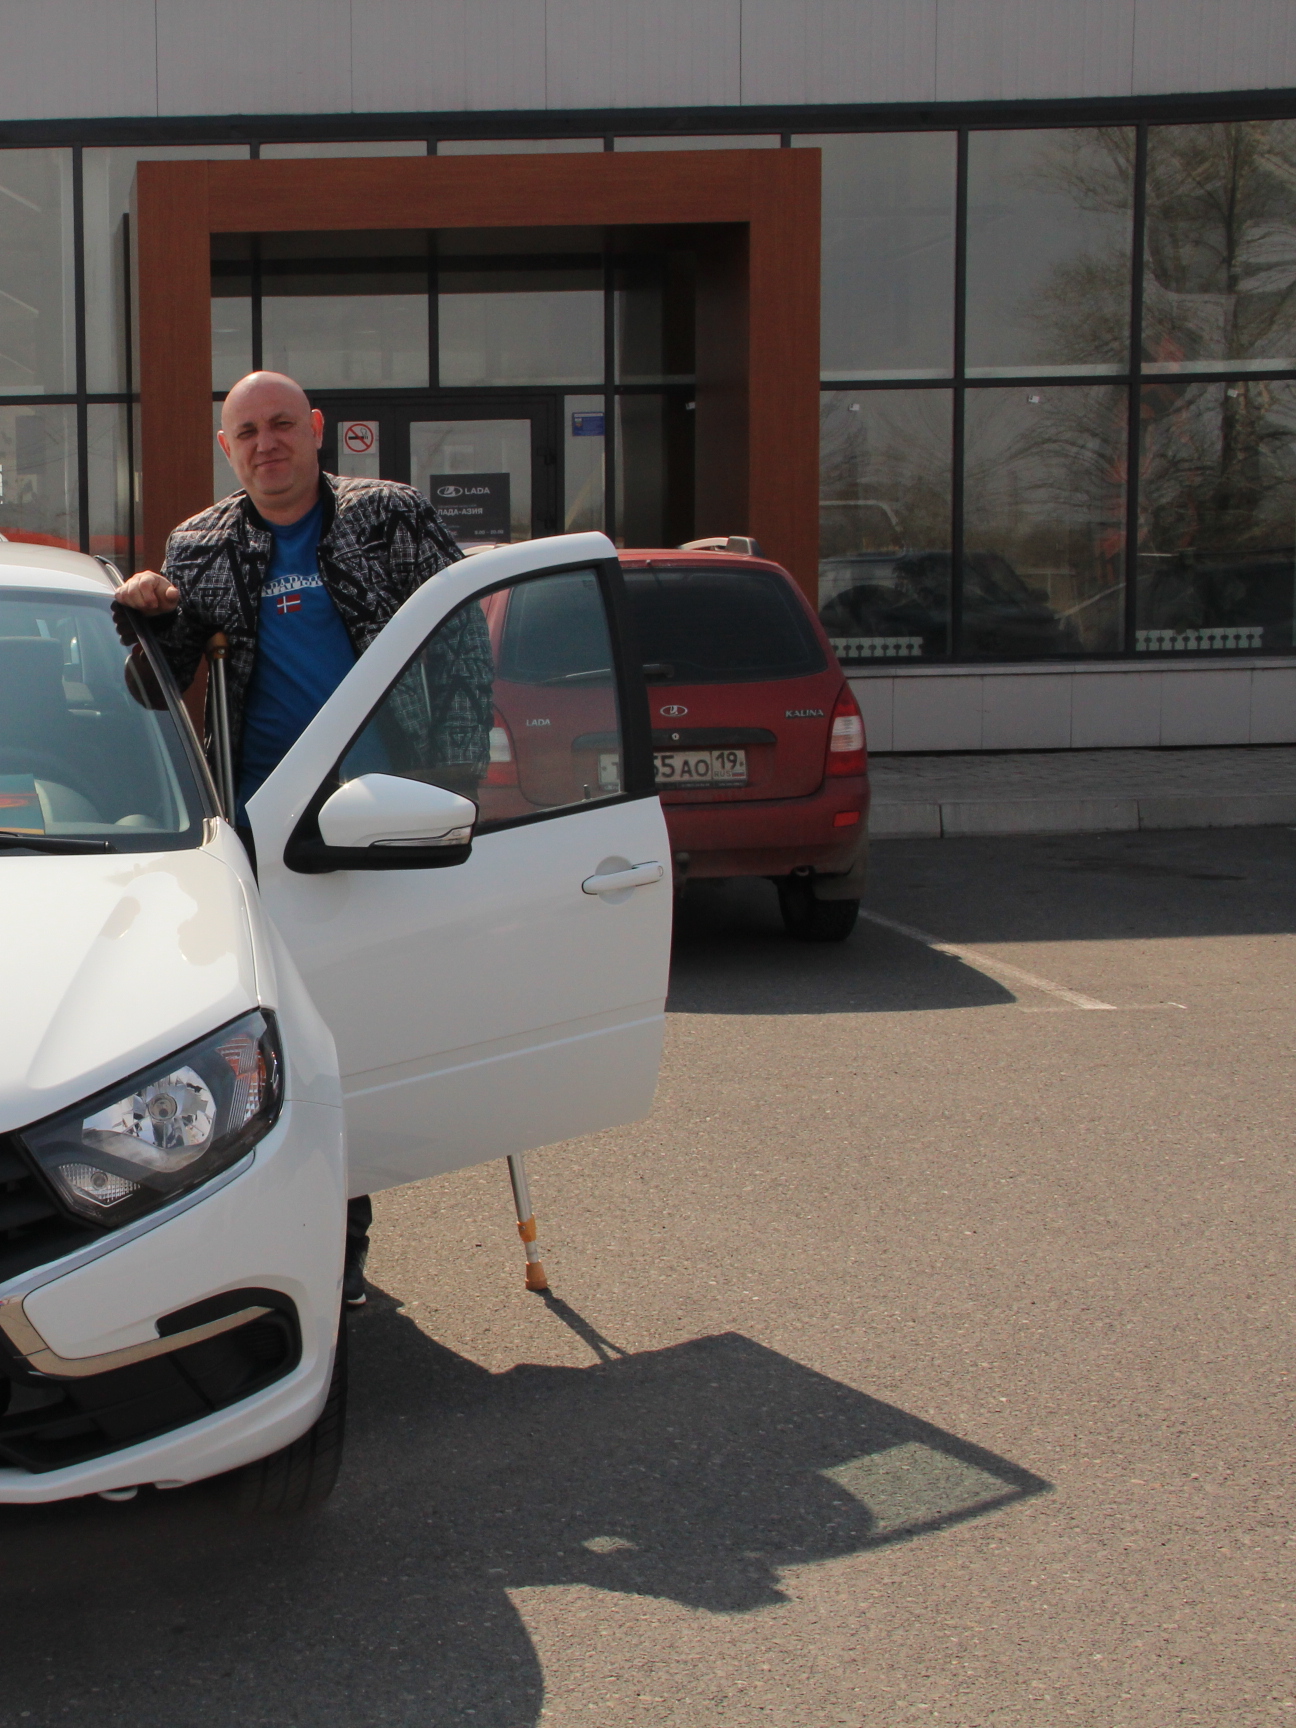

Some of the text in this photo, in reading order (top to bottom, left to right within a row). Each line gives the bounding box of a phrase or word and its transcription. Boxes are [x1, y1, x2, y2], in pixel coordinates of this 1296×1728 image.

[465, 487, 490, 495] LADA
[437, 507, 483, 516] ЛАДА-АЗИЯ
[785, 708, 824, 718] KALINA
[526, 718, 551, 727] LADA
[716, 752, 738, 770] 19
